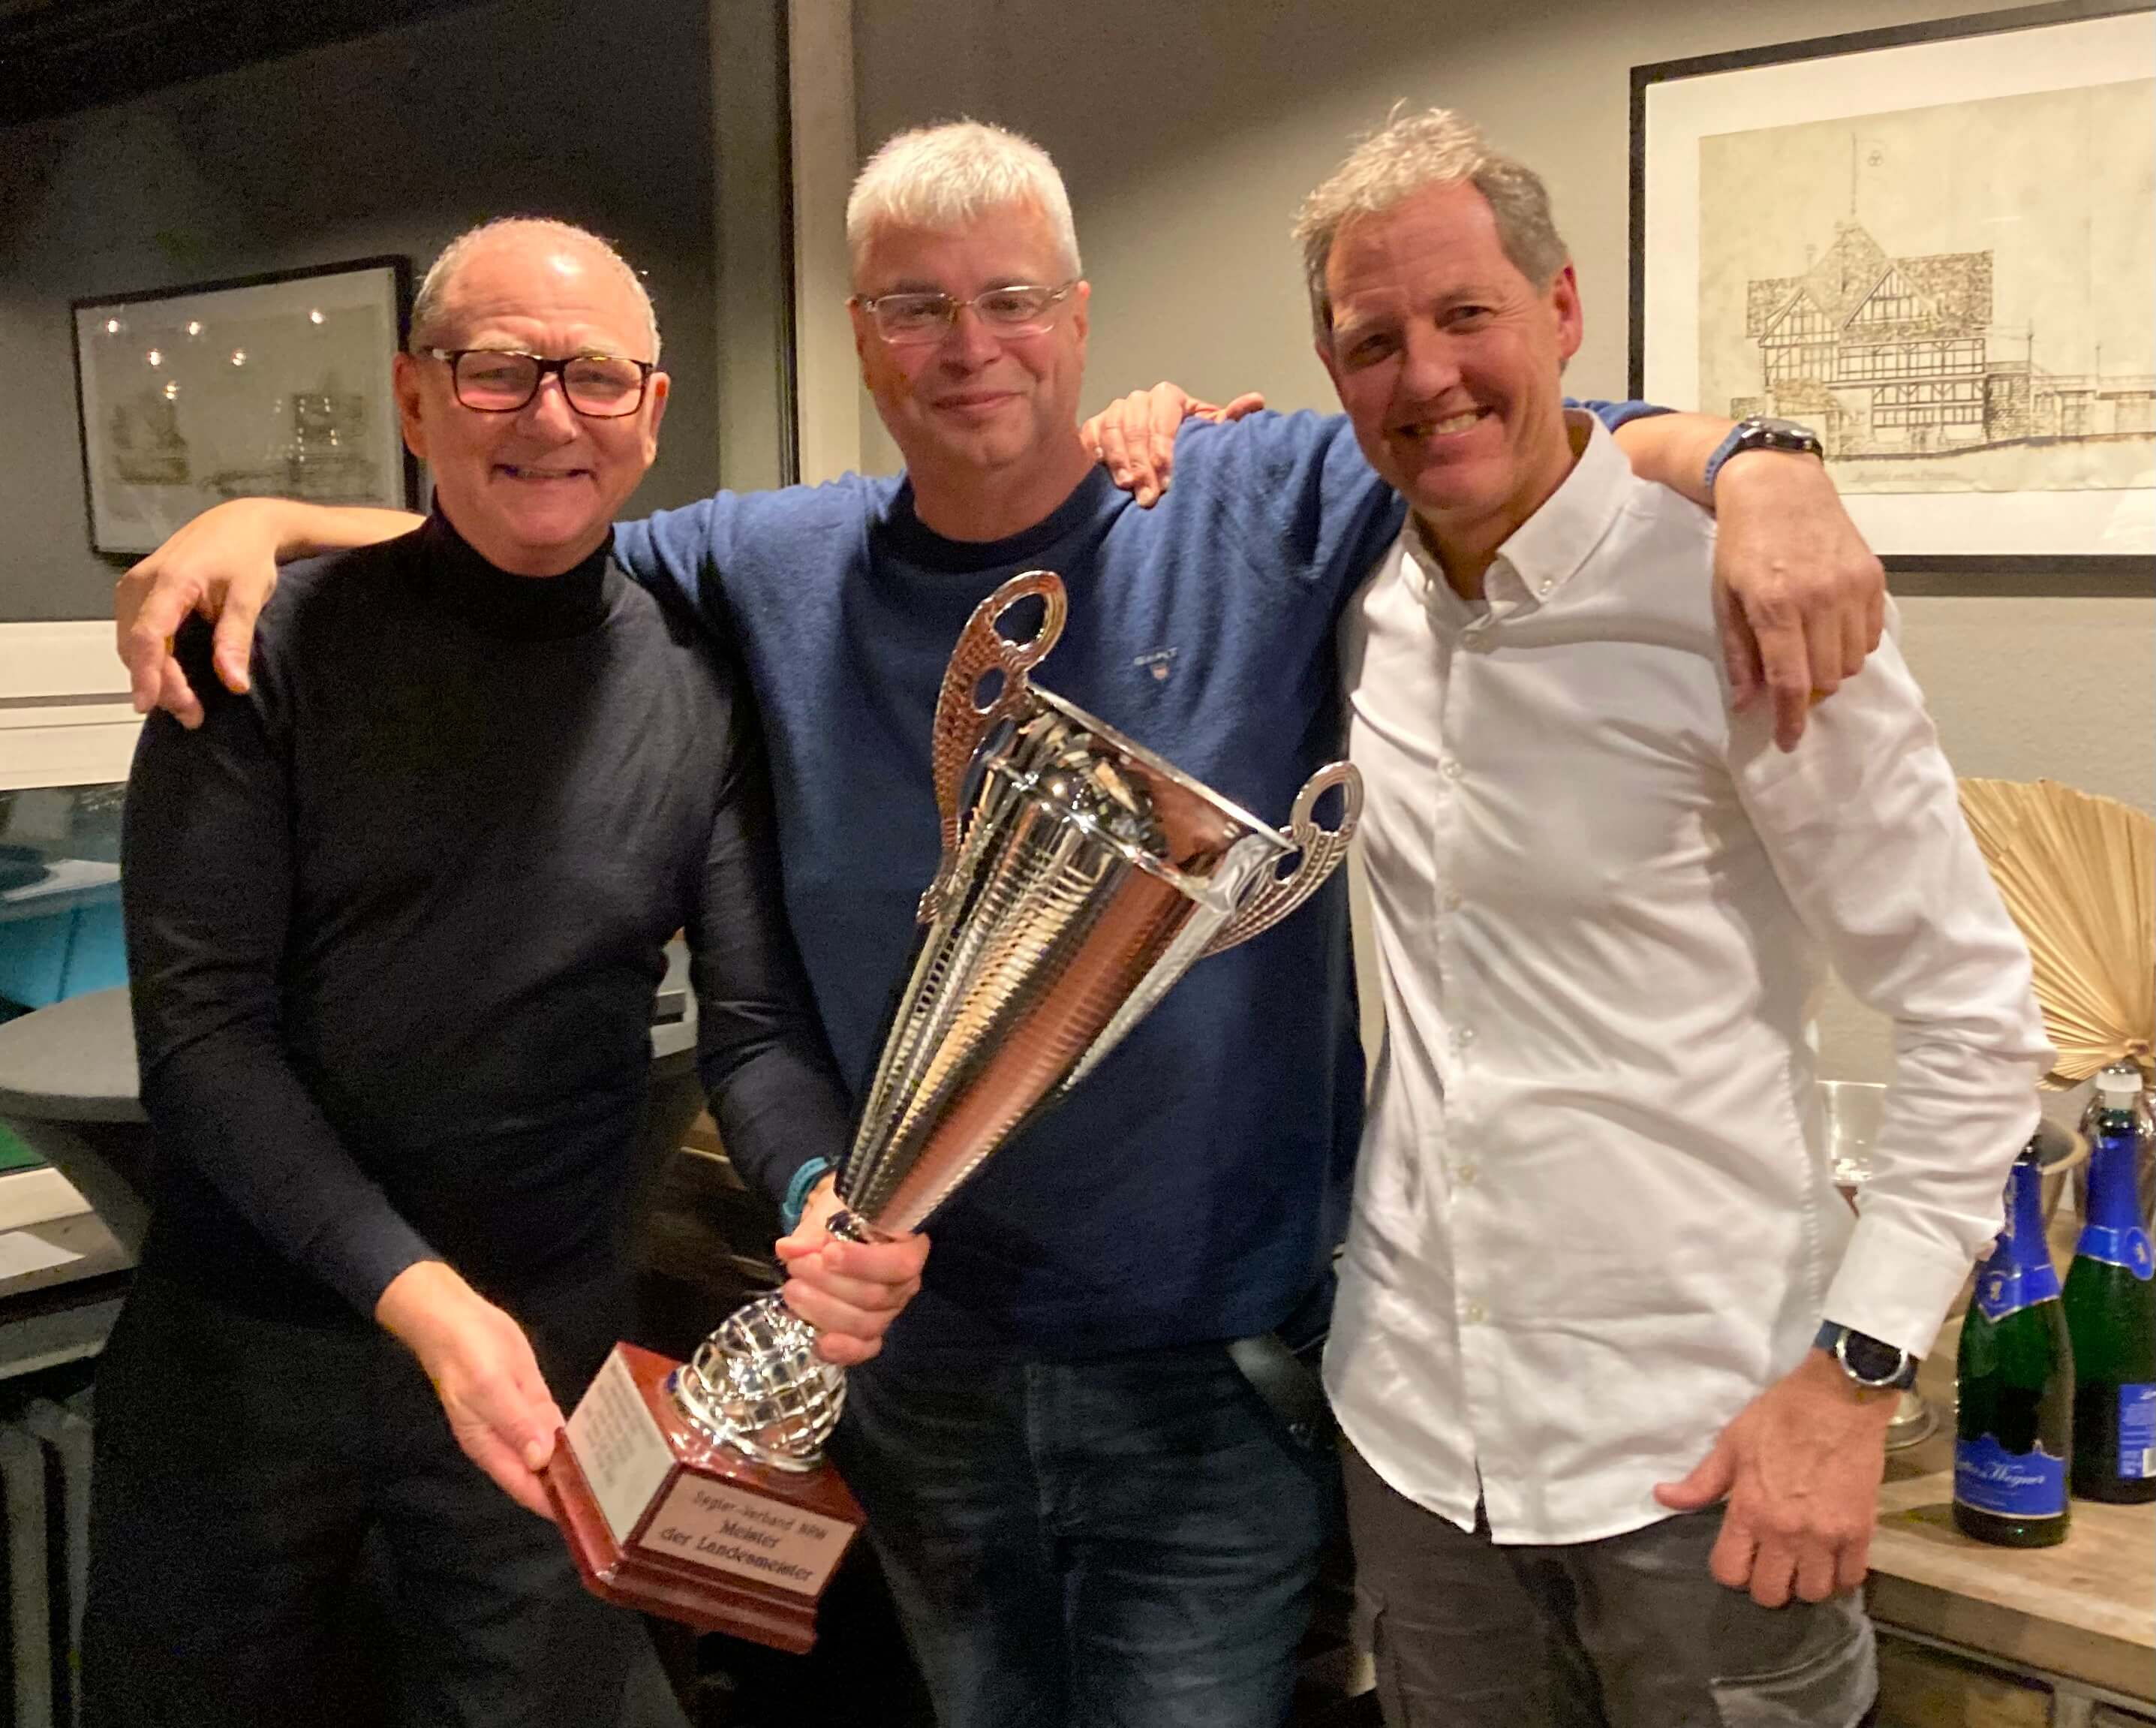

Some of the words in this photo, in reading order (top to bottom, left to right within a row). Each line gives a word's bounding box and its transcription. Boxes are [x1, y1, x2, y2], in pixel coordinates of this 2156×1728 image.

[660, 1525, 693, 1546] der
[696, 1535, 813, 1581] Landesmeister
[718, 1518, 780, 1549] Meister
